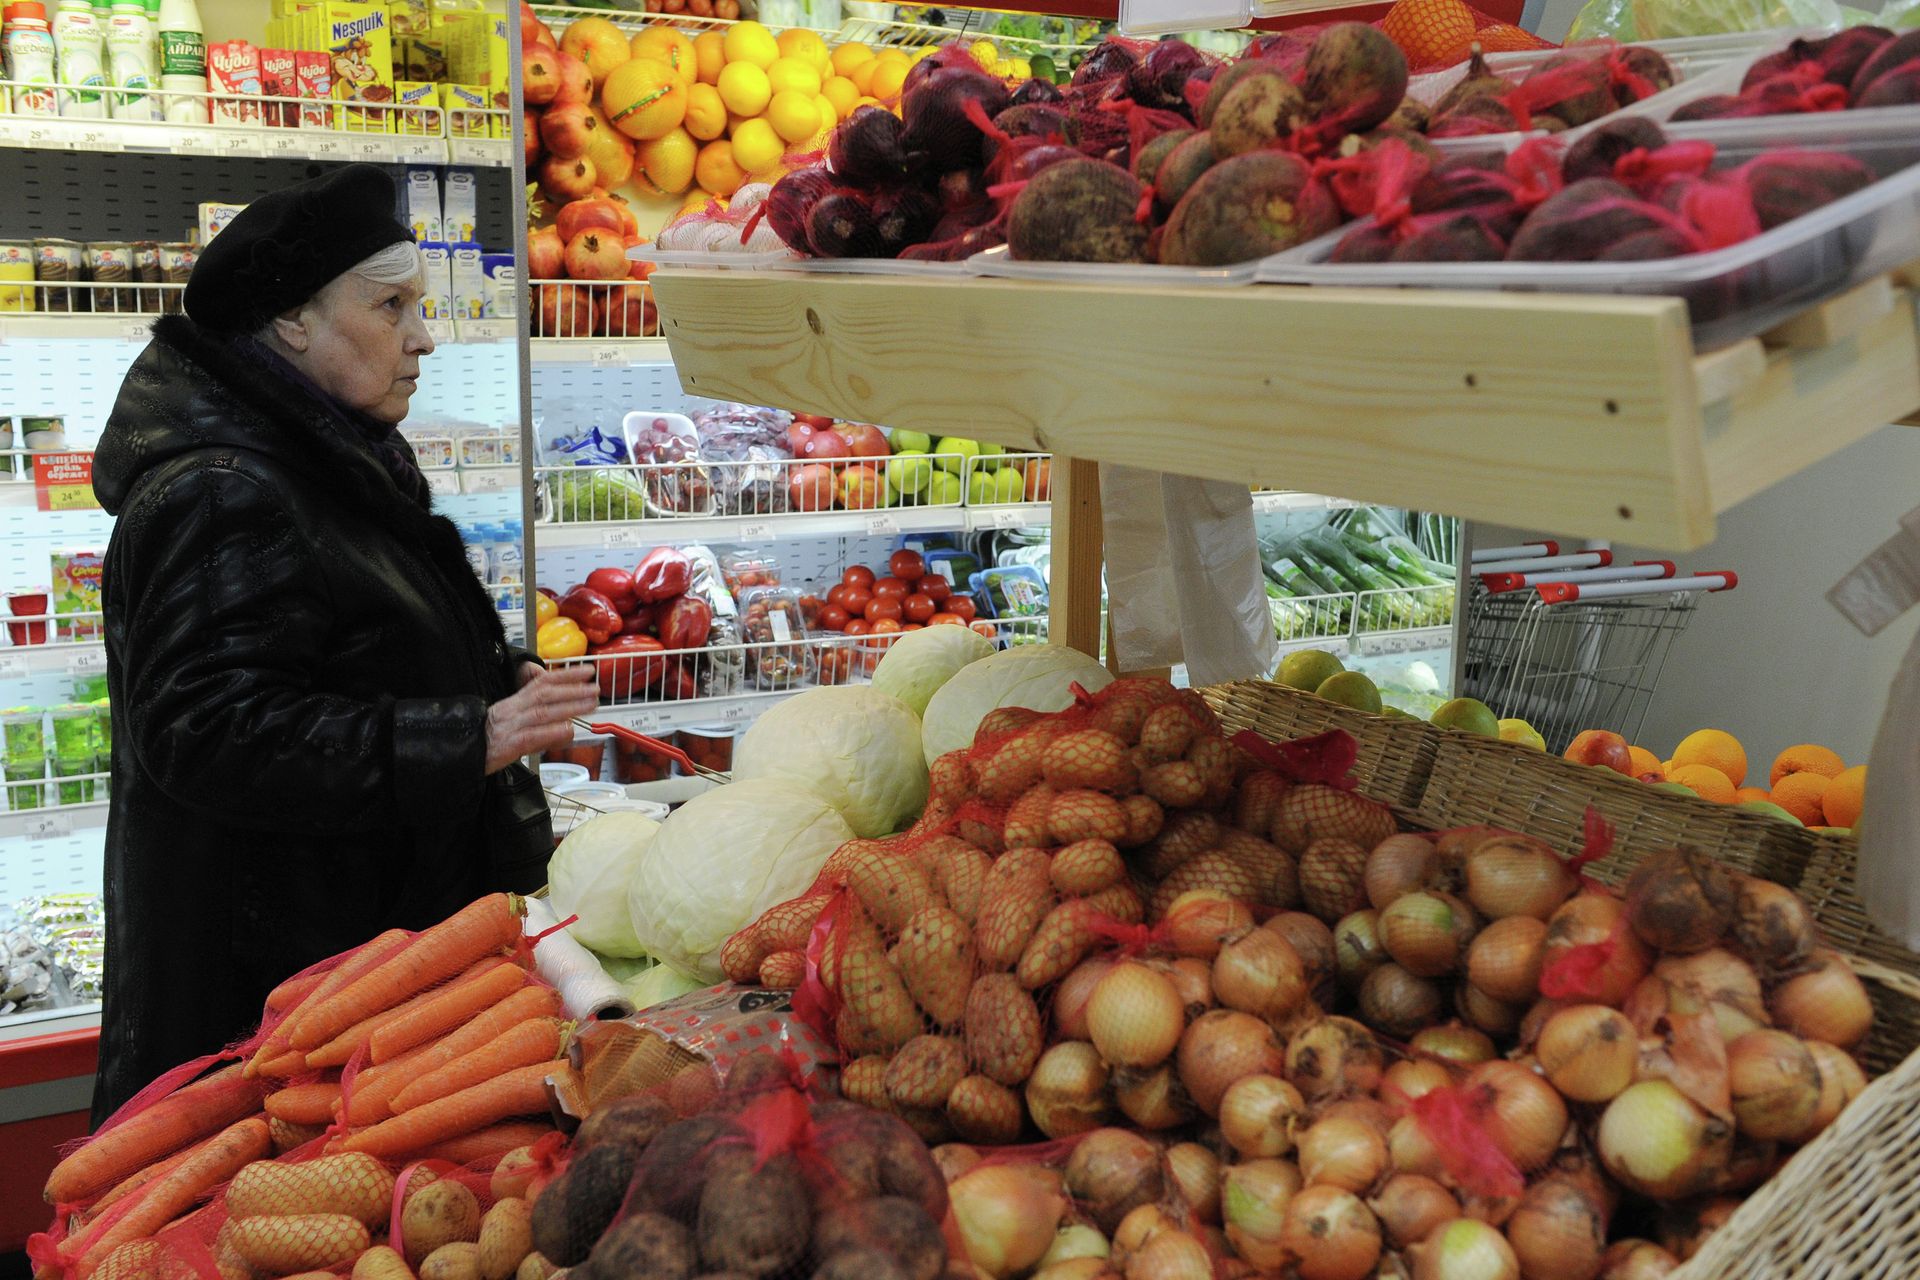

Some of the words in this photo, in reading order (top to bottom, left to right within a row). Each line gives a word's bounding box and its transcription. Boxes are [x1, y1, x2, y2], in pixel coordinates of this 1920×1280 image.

[332, 10, 384, 41] Nesquik
[213, 54, 250, 72] Чудо
[263, 58, 293, 74] Чудо
[299, 64, 326, 79] Чудо
[402, 83, 432, 102] Nesquik
[229, 140, 240, 148] 37
[277, 140, 287, 149] 18
[320, 143, 330, 152] 18
[363, 144, 373, 153] 82
[413, 146, 423, 155] 24
[132, 327, 144, 336] 23
[52, 463, 82, 472] рубль
[62, 492, 72, 501] 24
[78, 656, 88, 666] 61
